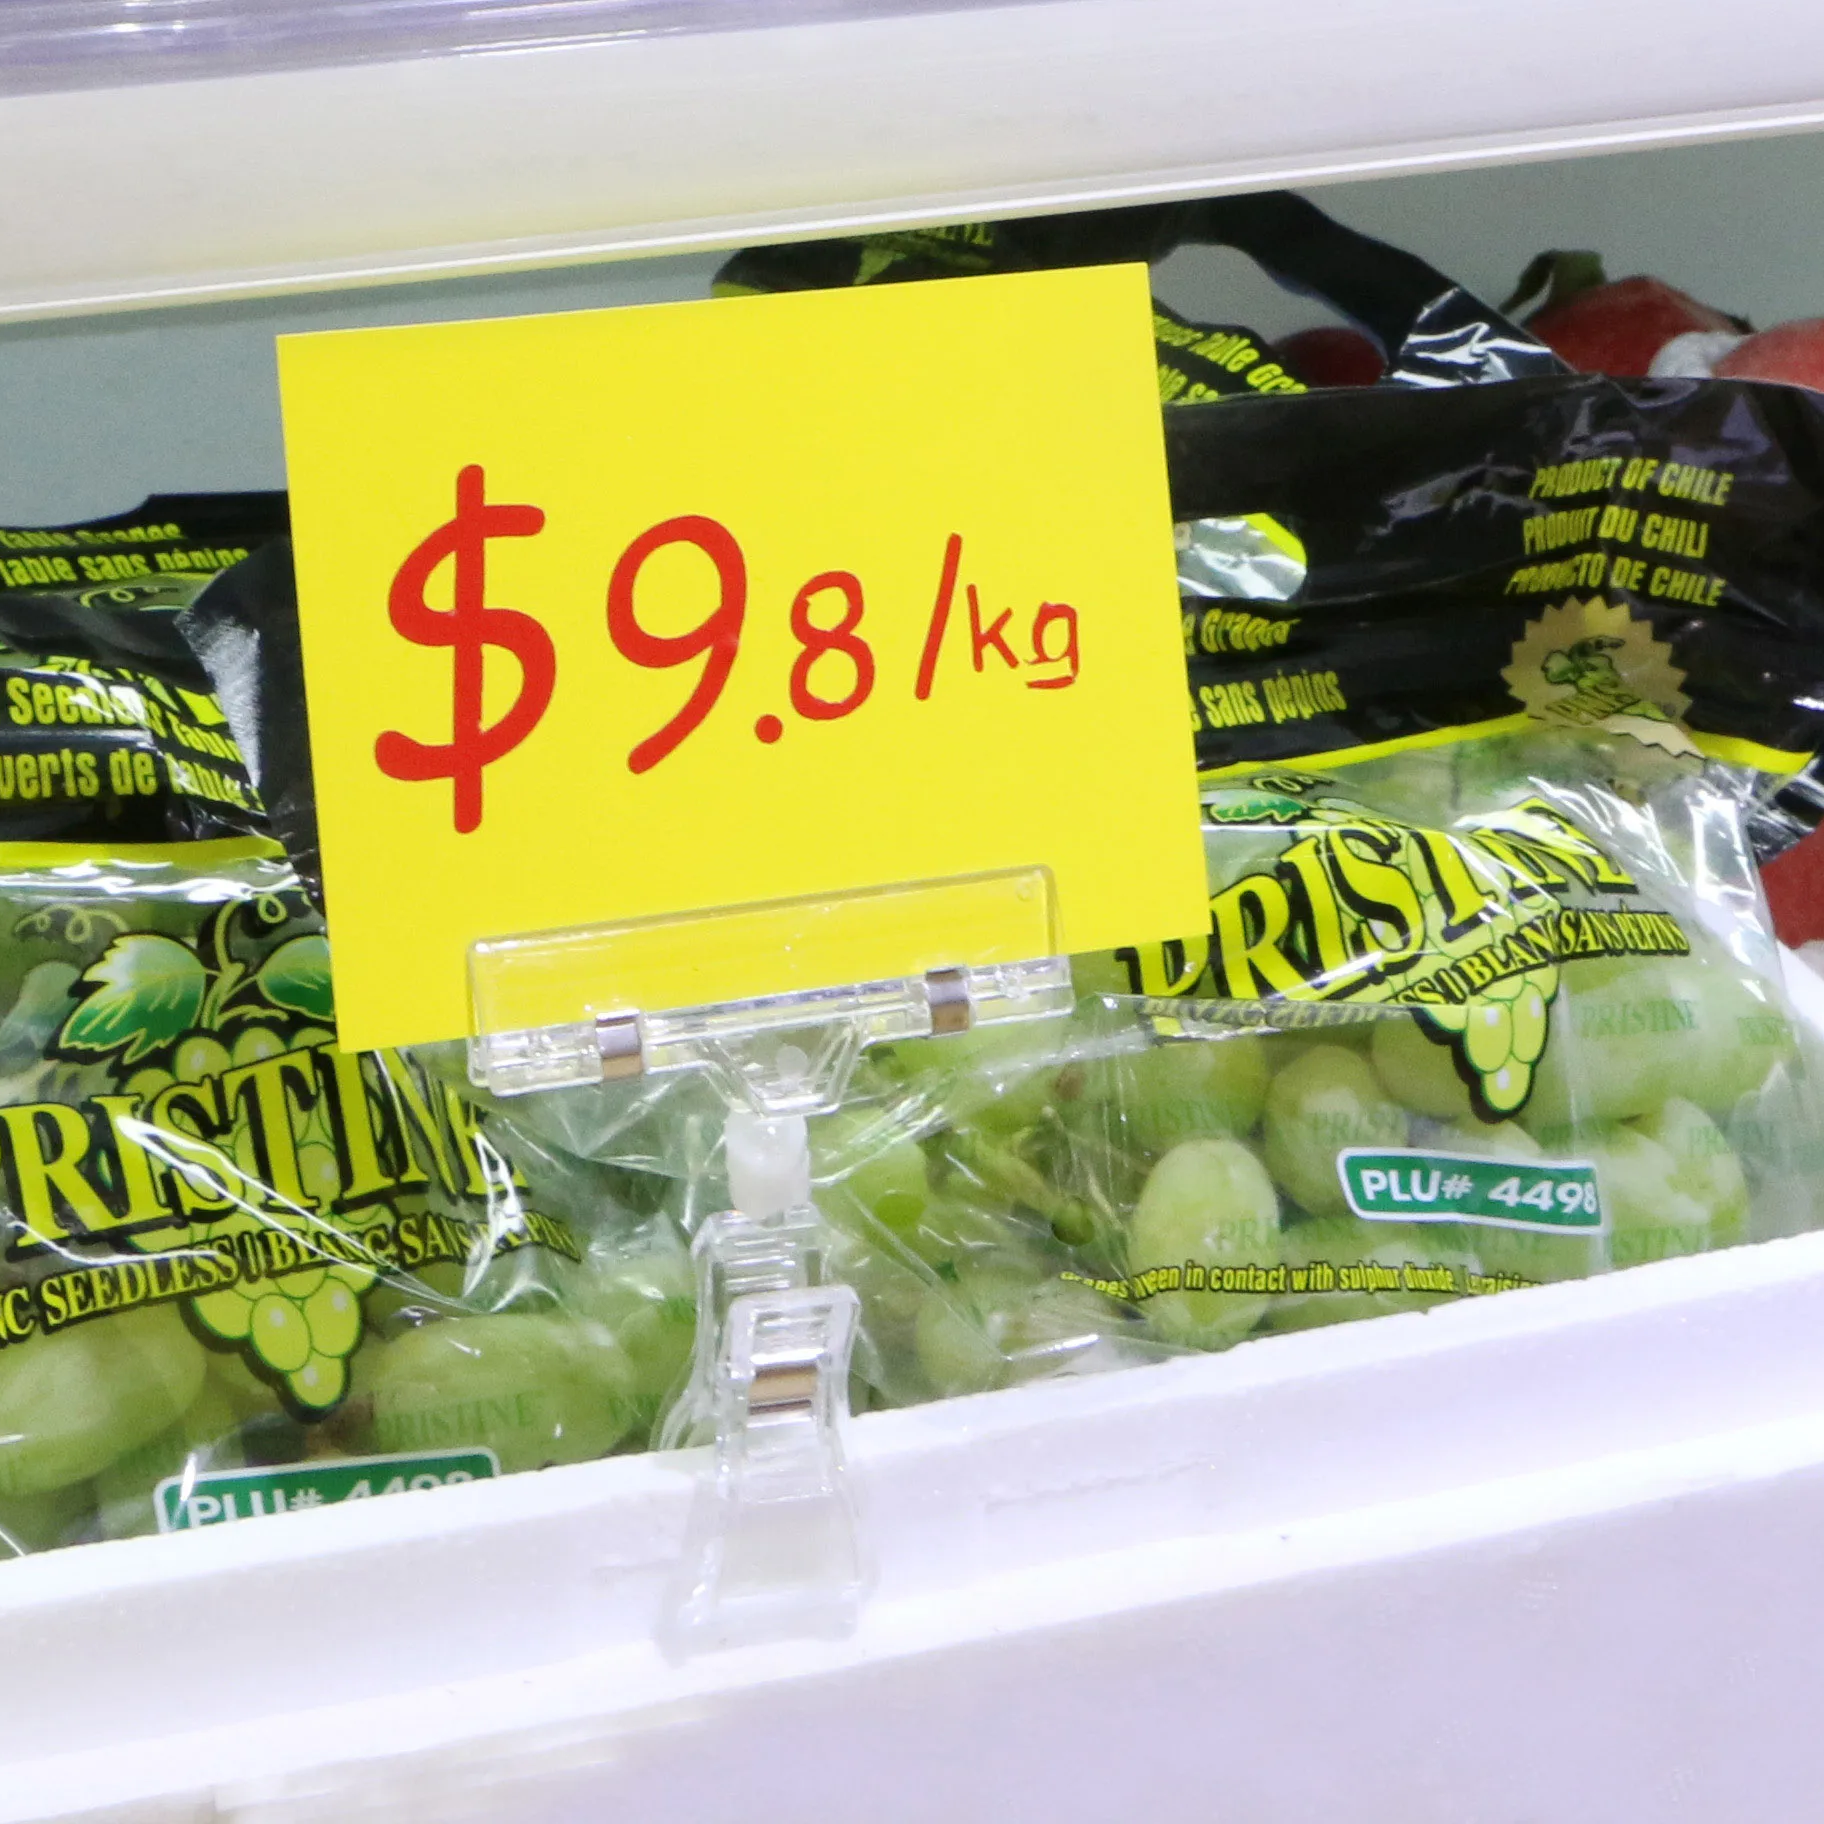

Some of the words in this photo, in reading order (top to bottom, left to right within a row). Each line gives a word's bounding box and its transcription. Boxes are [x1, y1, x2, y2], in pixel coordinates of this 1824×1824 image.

[1528, 456, 1623, 500] PRODUCT
[1621, 456, 1659, 492] OF
[1658, 462, 1734, 507] CHILE
[1523, 506, 1600, 556] PRODUIT
[1598, 505, 1639, 543] DU
[1641, 512, 1709, 559] CHILI
[76, 552, 153, 582] sans
[1609, 556, 1648, 592] DE
[1649, 566, 1727, 607] CHILE
[1198, 679, 1266, 728] sans
[108, 747, 158, 797] de
[1360, 1164, 1473, 1205] PLU#
[1486, 1175, 1599, 1217] 4498
[41, 1238, 240, 1328] SEEDLESS
[1184, 1259, 1206, 1290] in
[1210, 1263, 1287, 1293] contact
[1291, 1261, 1336, 1293] with
[1338, 1259, 1402, 1295] sulphur
